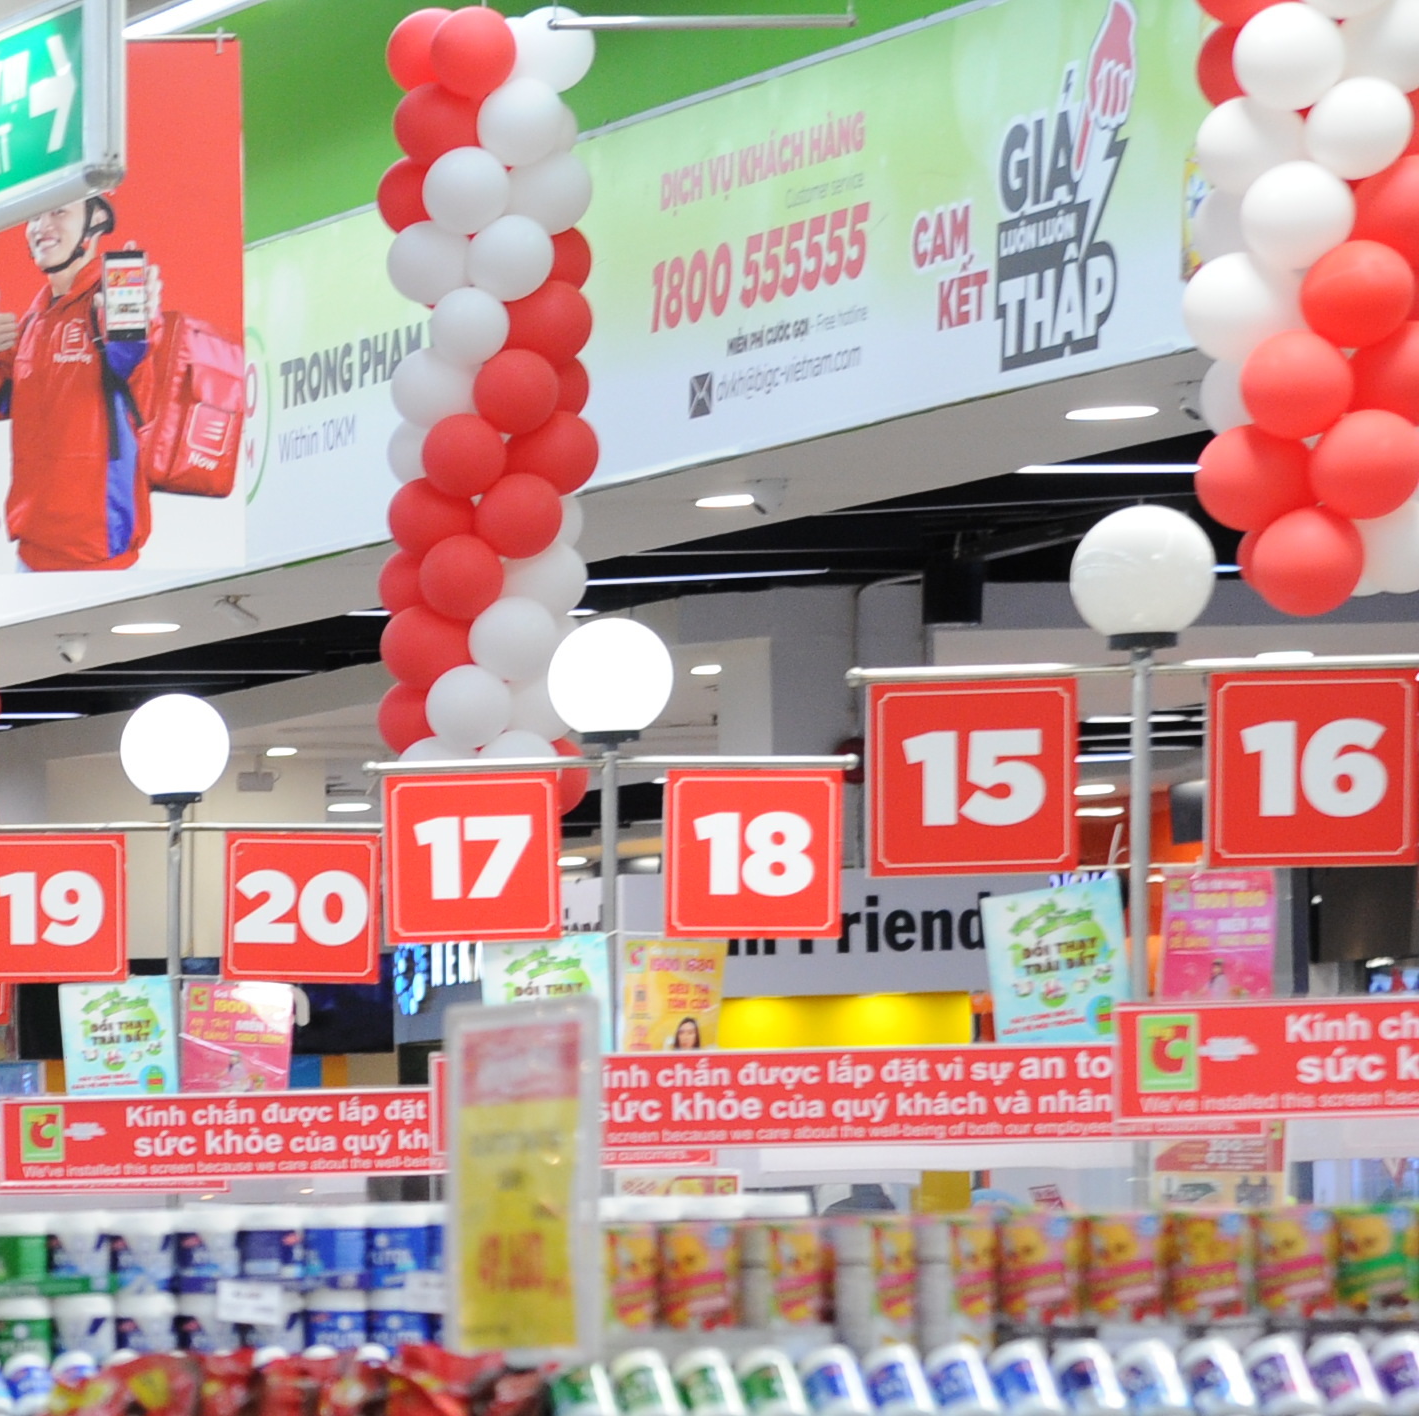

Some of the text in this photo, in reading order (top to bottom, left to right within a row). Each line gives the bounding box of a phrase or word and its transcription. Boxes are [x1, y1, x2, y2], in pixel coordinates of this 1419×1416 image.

[660, 110, 866, 217] DỊCH VỤ KHÁCH HÀNG
[1000, 67, 1079, 213] GIÁ
[913, 204, 971, 269] CAM
[1000, 211, 1077, 257] LUÔN LUÔN
[650, 201, 871, 334] 1800 555555
[937, 254, 989, 332] KẾT
[280, 342, 353, 410] TRONG
[187, 452, 218, 471] Now
[278, 413, 357, 464] Within 10KM
[902, 729, 1046, 827] 15
[1240, 718, 1388, 817] 16
[413, 815, 532, 900] 17
[693, 811, 814, 896] 18
[233, 869, 368, 945] 20
[803, 892, 991, 954] riend
[1285, 1011, 1371, 1042] Kính
[604, 1054, 1070, 1090] ính chắn được lắp đặt vì sự an
[1297, 1045, 1386, 1083] sức
[127, 1097, 427, 1128] Kính chắn được lắp đặt
[599, 1088, 1112, 1124] sức khỏe của quý khách và nhân
[663, 1125, 725, 1142] because
[729, 1128, 754, 1140] we
[757, 1128, 786, 1139] care
[789, 1123, 836, 1139] about
[839, 1122, 863, 1138] the
[967, 1120, 1000, 1136] both
[1004, 1123, 1030, 1135] our
